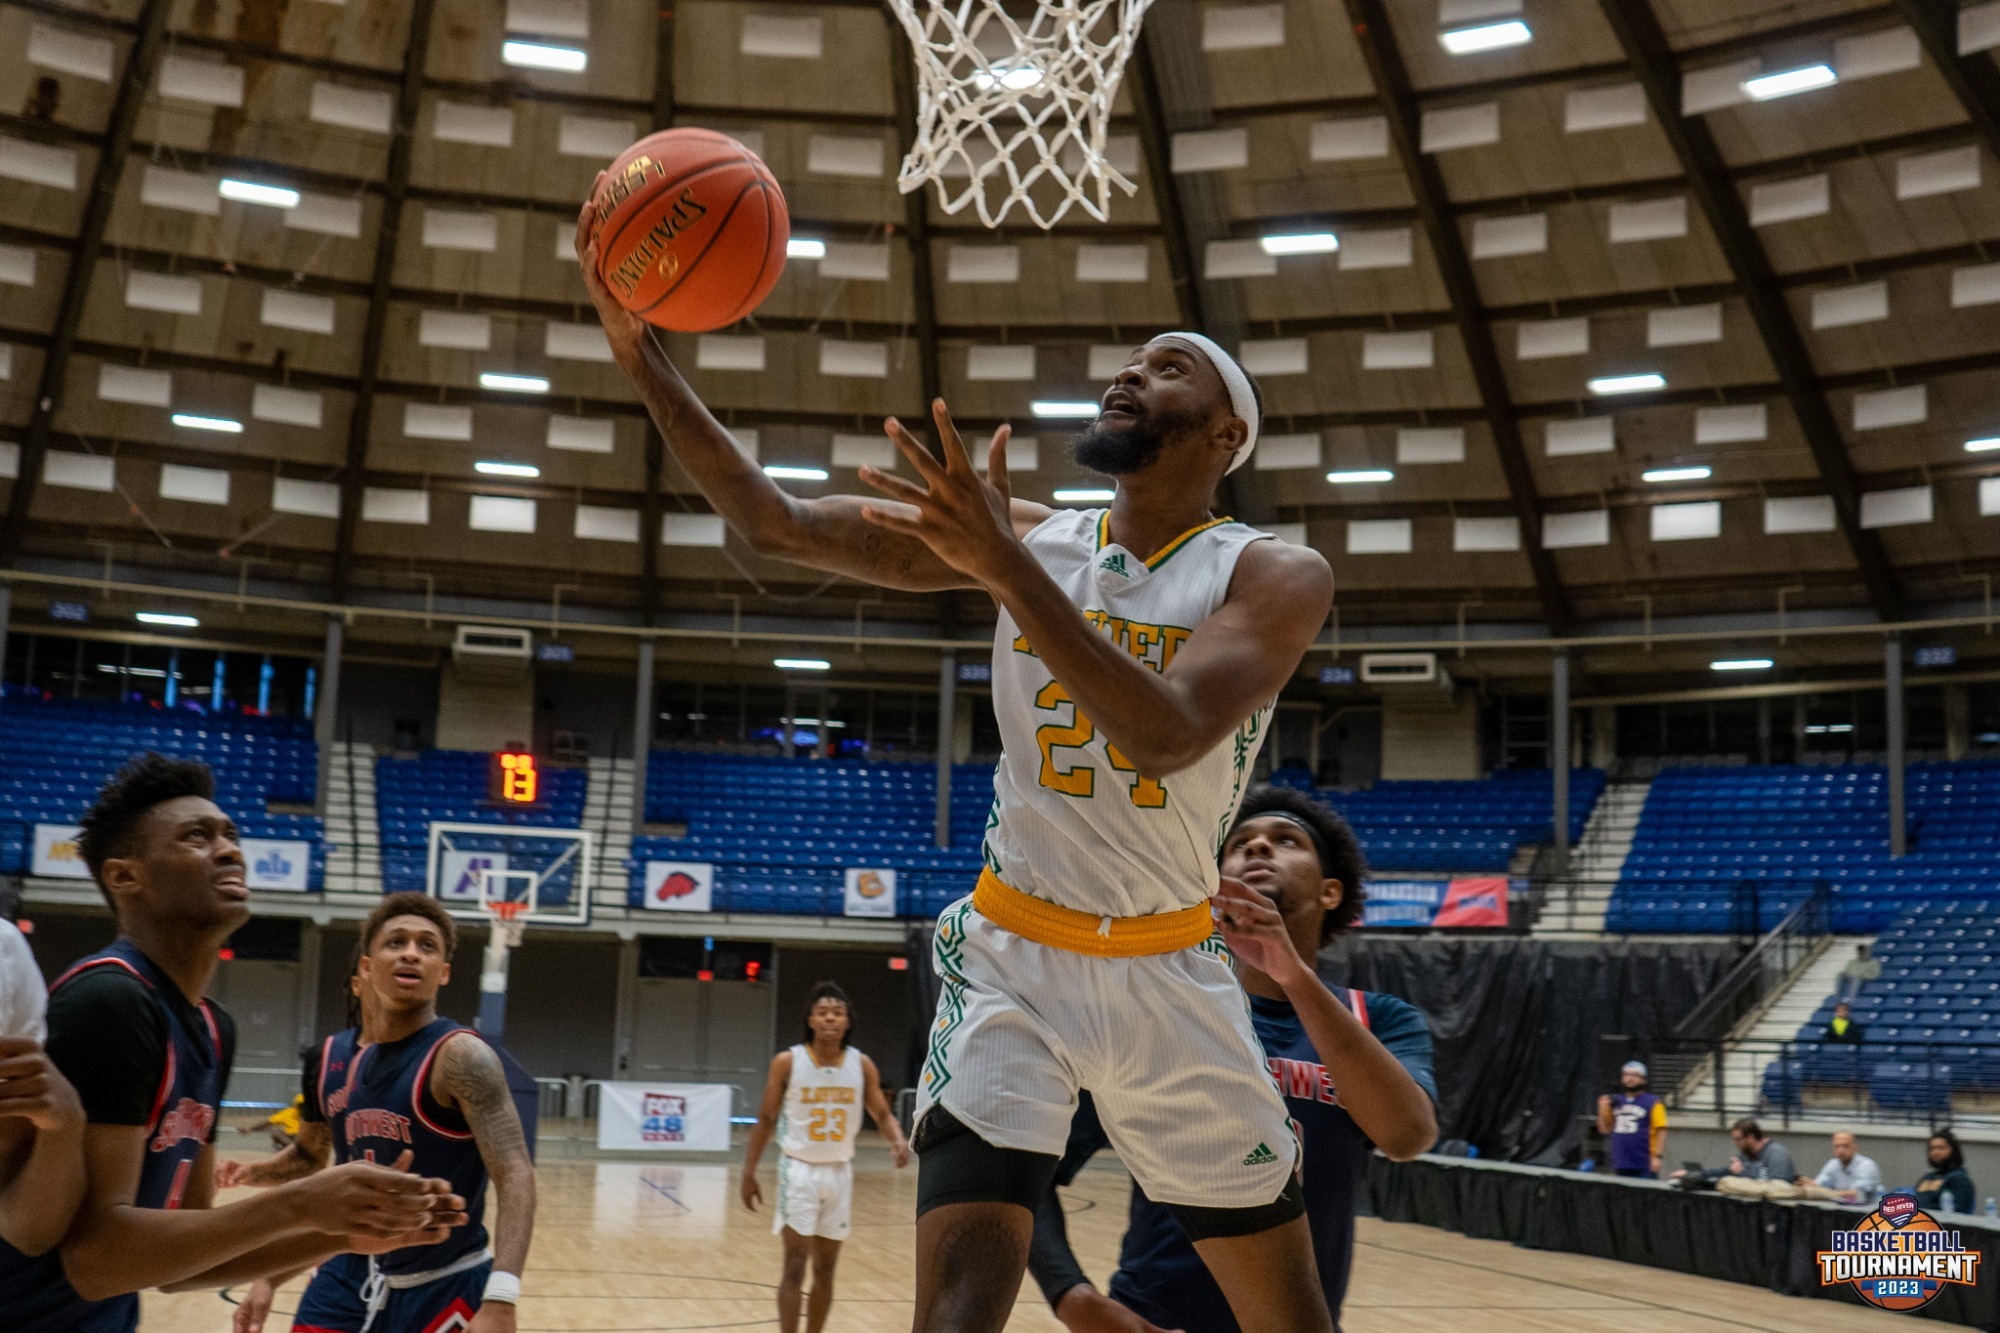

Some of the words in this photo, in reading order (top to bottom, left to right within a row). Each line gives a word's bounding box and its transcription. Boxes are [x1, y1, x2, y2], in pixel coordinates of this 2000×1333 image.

[611, 186, 708, 299] SPALDING
[502, 768, 537, 802] 13
[808, 1107, 846, 1142] 23
[1242, 1153, 1278, 1167] adidas
